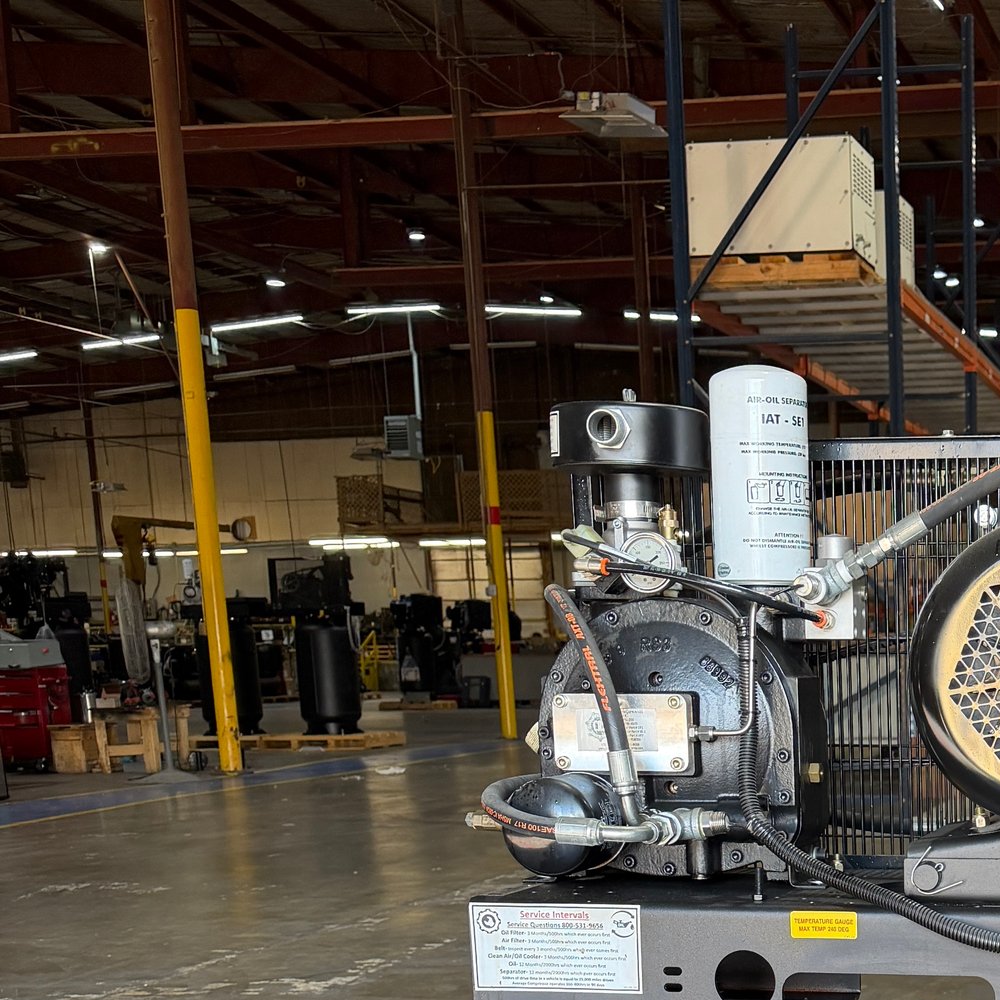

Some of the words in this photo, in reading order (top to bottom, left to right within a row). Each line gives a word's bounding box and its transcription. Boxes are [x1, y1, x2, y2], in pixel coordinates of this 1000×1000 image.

[747, 396, 780, 404] AIR-OIL
[762, 414, 780, 424] IAT
[553, 911, 589, 919] Intervals
